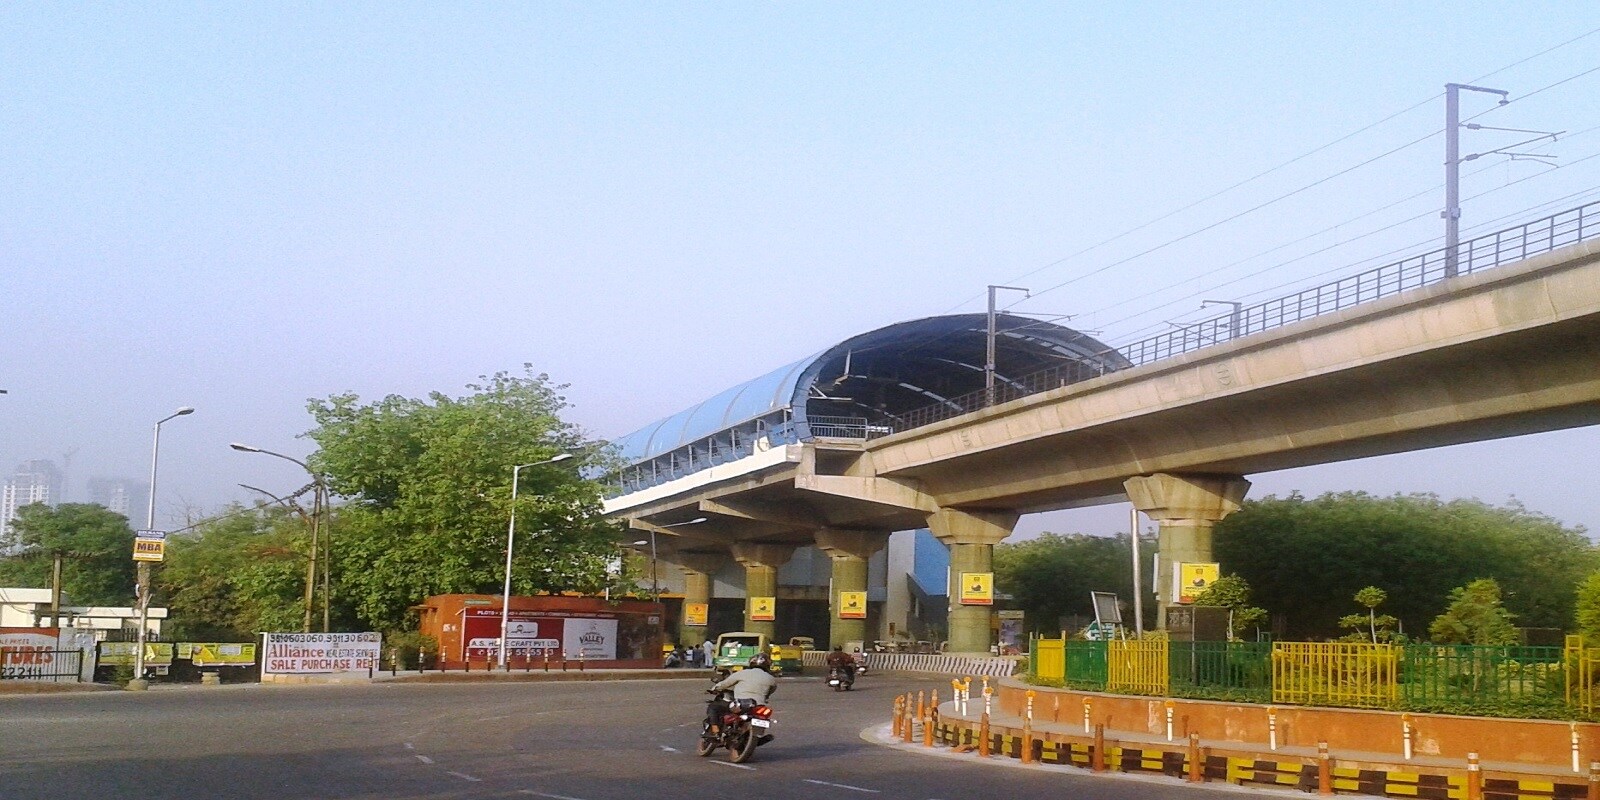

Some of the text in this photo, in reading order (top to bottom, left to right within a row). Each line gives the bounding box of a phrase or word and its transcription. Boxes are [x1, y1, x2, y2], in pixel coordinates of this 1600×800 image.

[137, 543, 161, 551] MBA
[579, 635, 606, 645] VALLEY
[269, 644, 324, 658] Alliance
[270, 659, 380, 670] SALE PURCHASE RET
